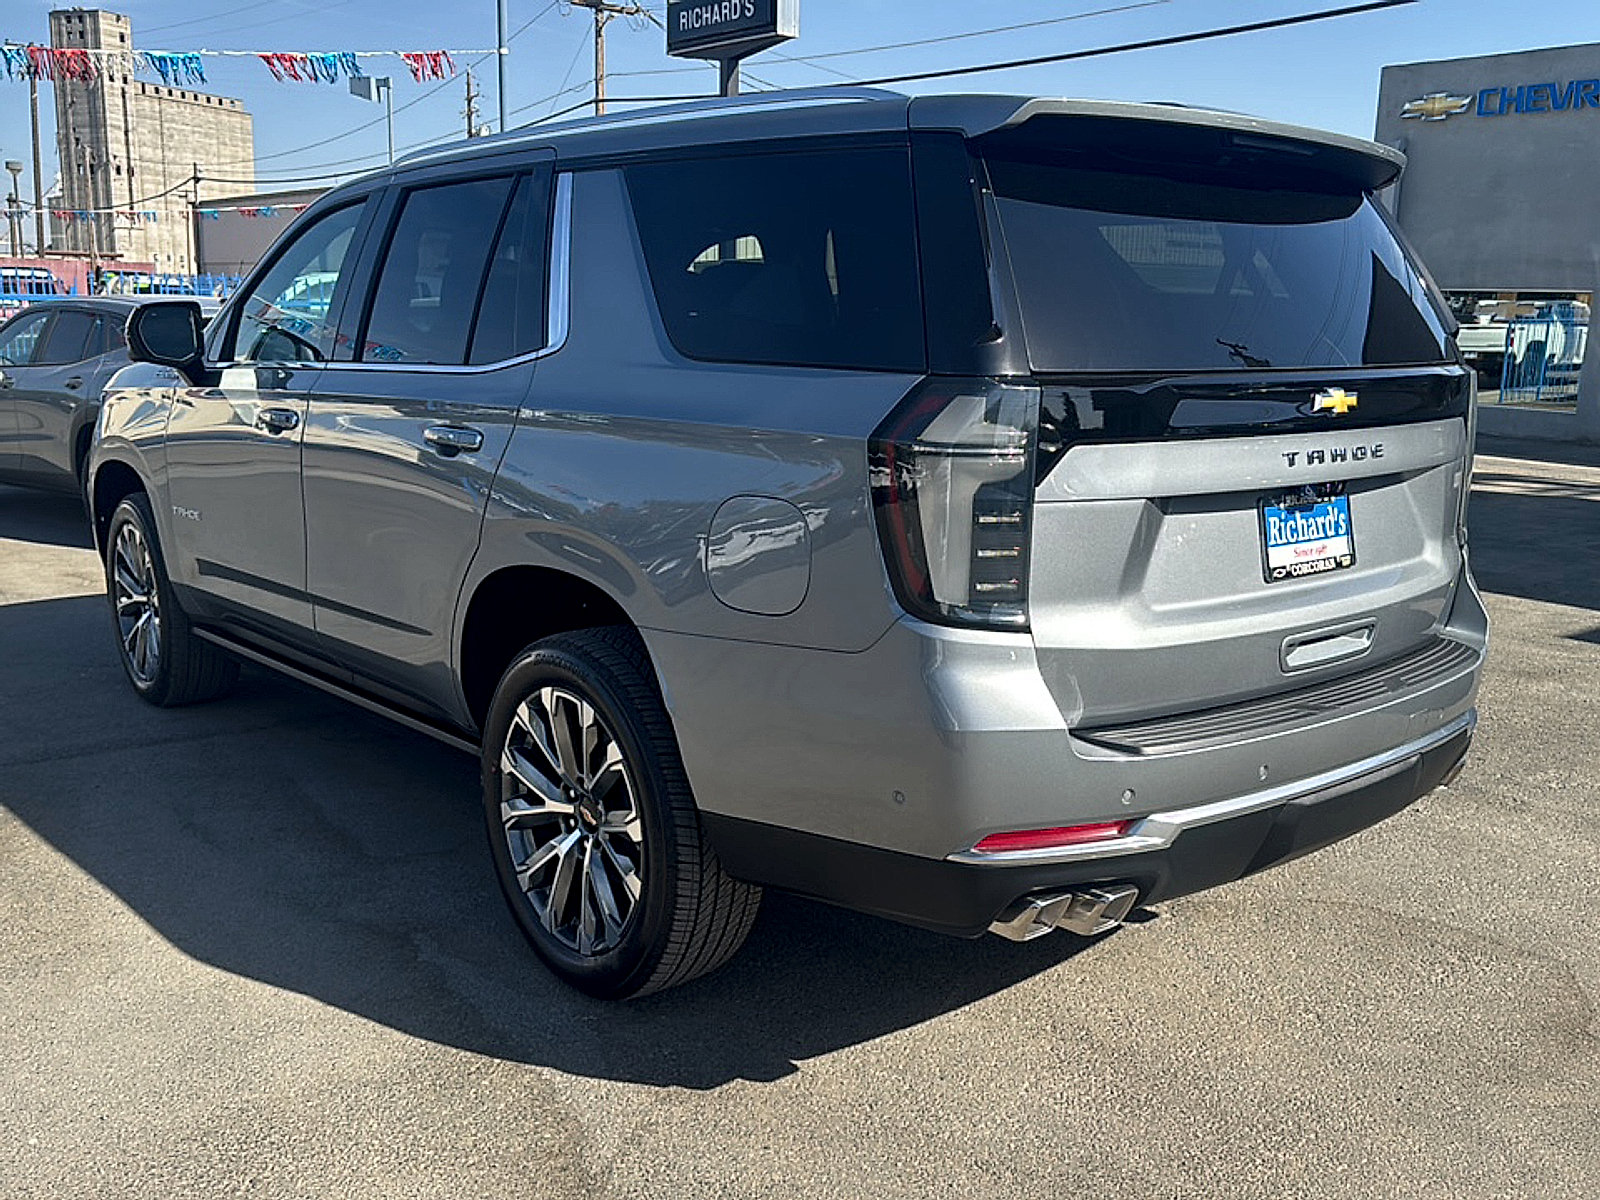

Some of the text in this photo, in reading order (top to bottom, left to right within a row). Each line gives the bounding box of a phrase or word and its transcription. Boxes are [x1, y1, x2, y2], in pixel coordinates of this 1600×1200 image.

[680, 0, 755, 31] RICHARD'S
[1281, 443, 1384, 468] TAHOE
[172, 505, 202, 522] TAHOE
[1268, 504, 1347, 546] Richard's
[1291, 558, 1336, 577] CORCORAN
